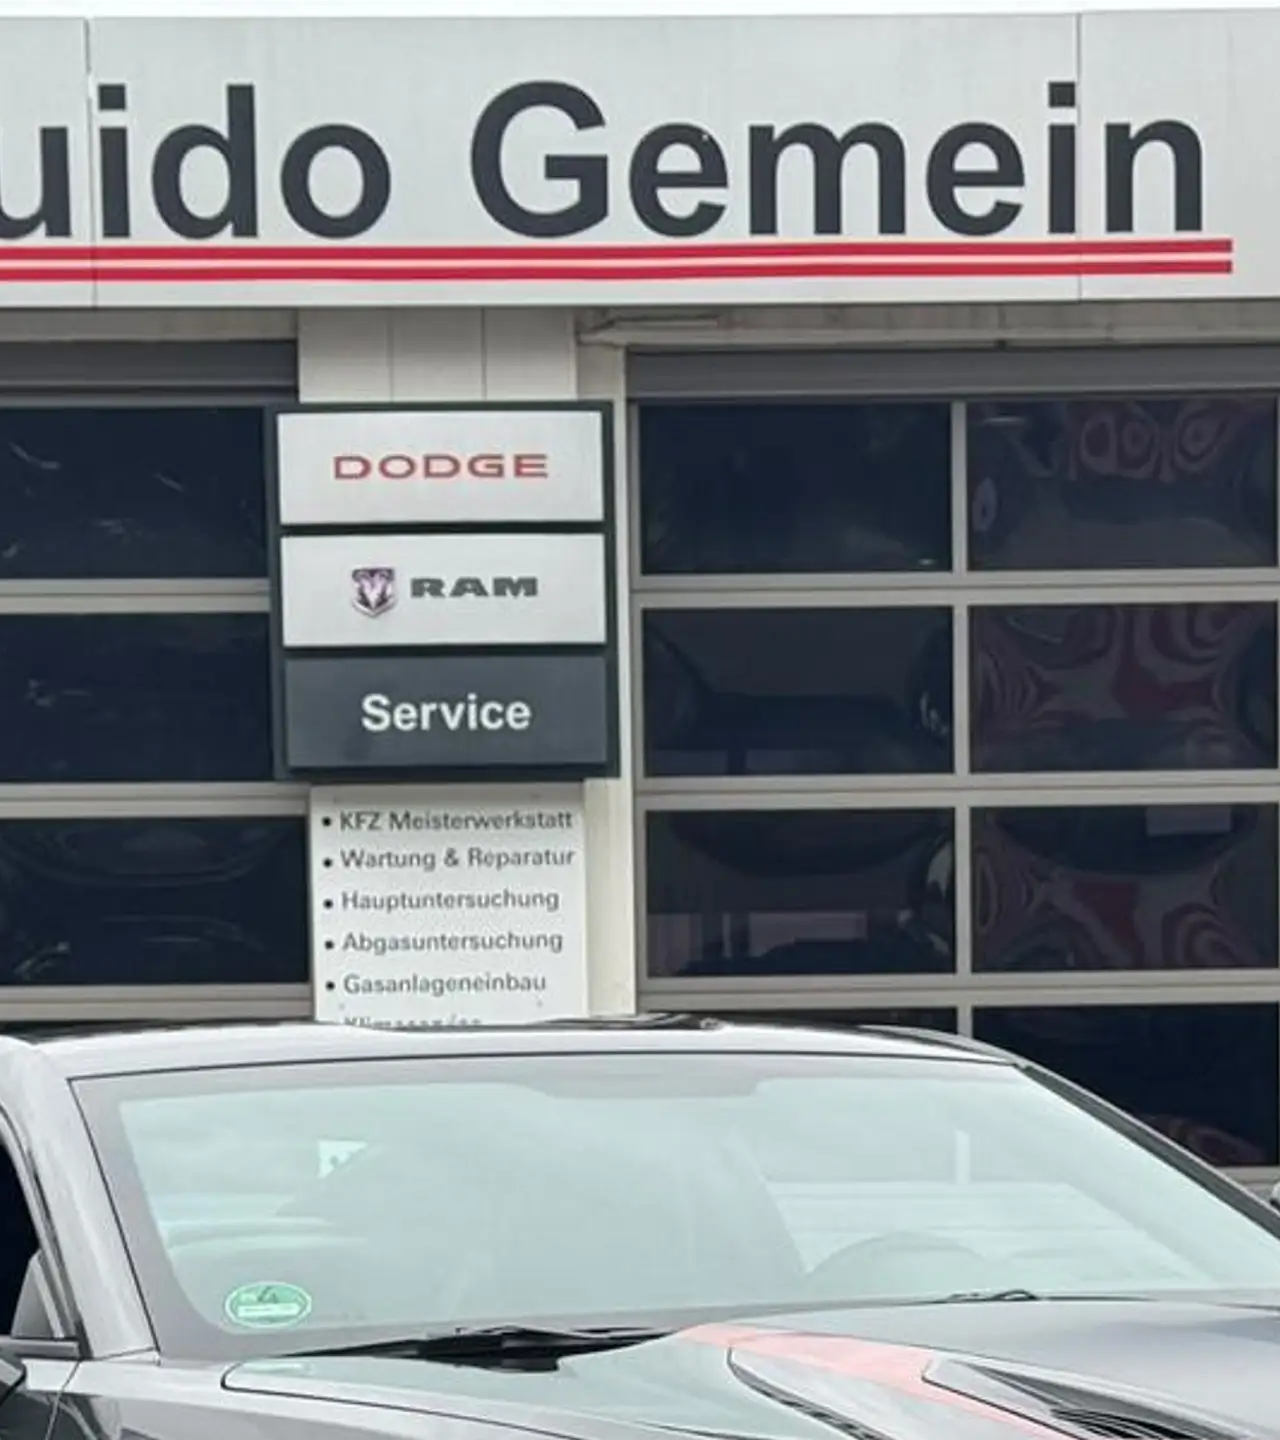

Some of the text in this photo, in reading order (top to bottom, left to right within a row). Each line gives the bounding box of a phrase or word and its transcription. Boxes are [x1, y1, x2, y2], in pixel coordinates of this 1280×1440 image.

[469, 80, 1205, 238] Gemein
[333, 454, 549, 480] DODGE
[410, 576, 539, 599] RAM
[361, 693, 532, 731] Service
[339, 811, 573, 831] KFZ Meisterwerkstatt
[340, 847, 576, 871] Wartung & Reparatur
[341, 889, 560, 912] Hauptuntersuchung
[342, 931, 563, 955] Abgasuntersuchung
[343, 972, 547, 997] Gasanlageneinbau
